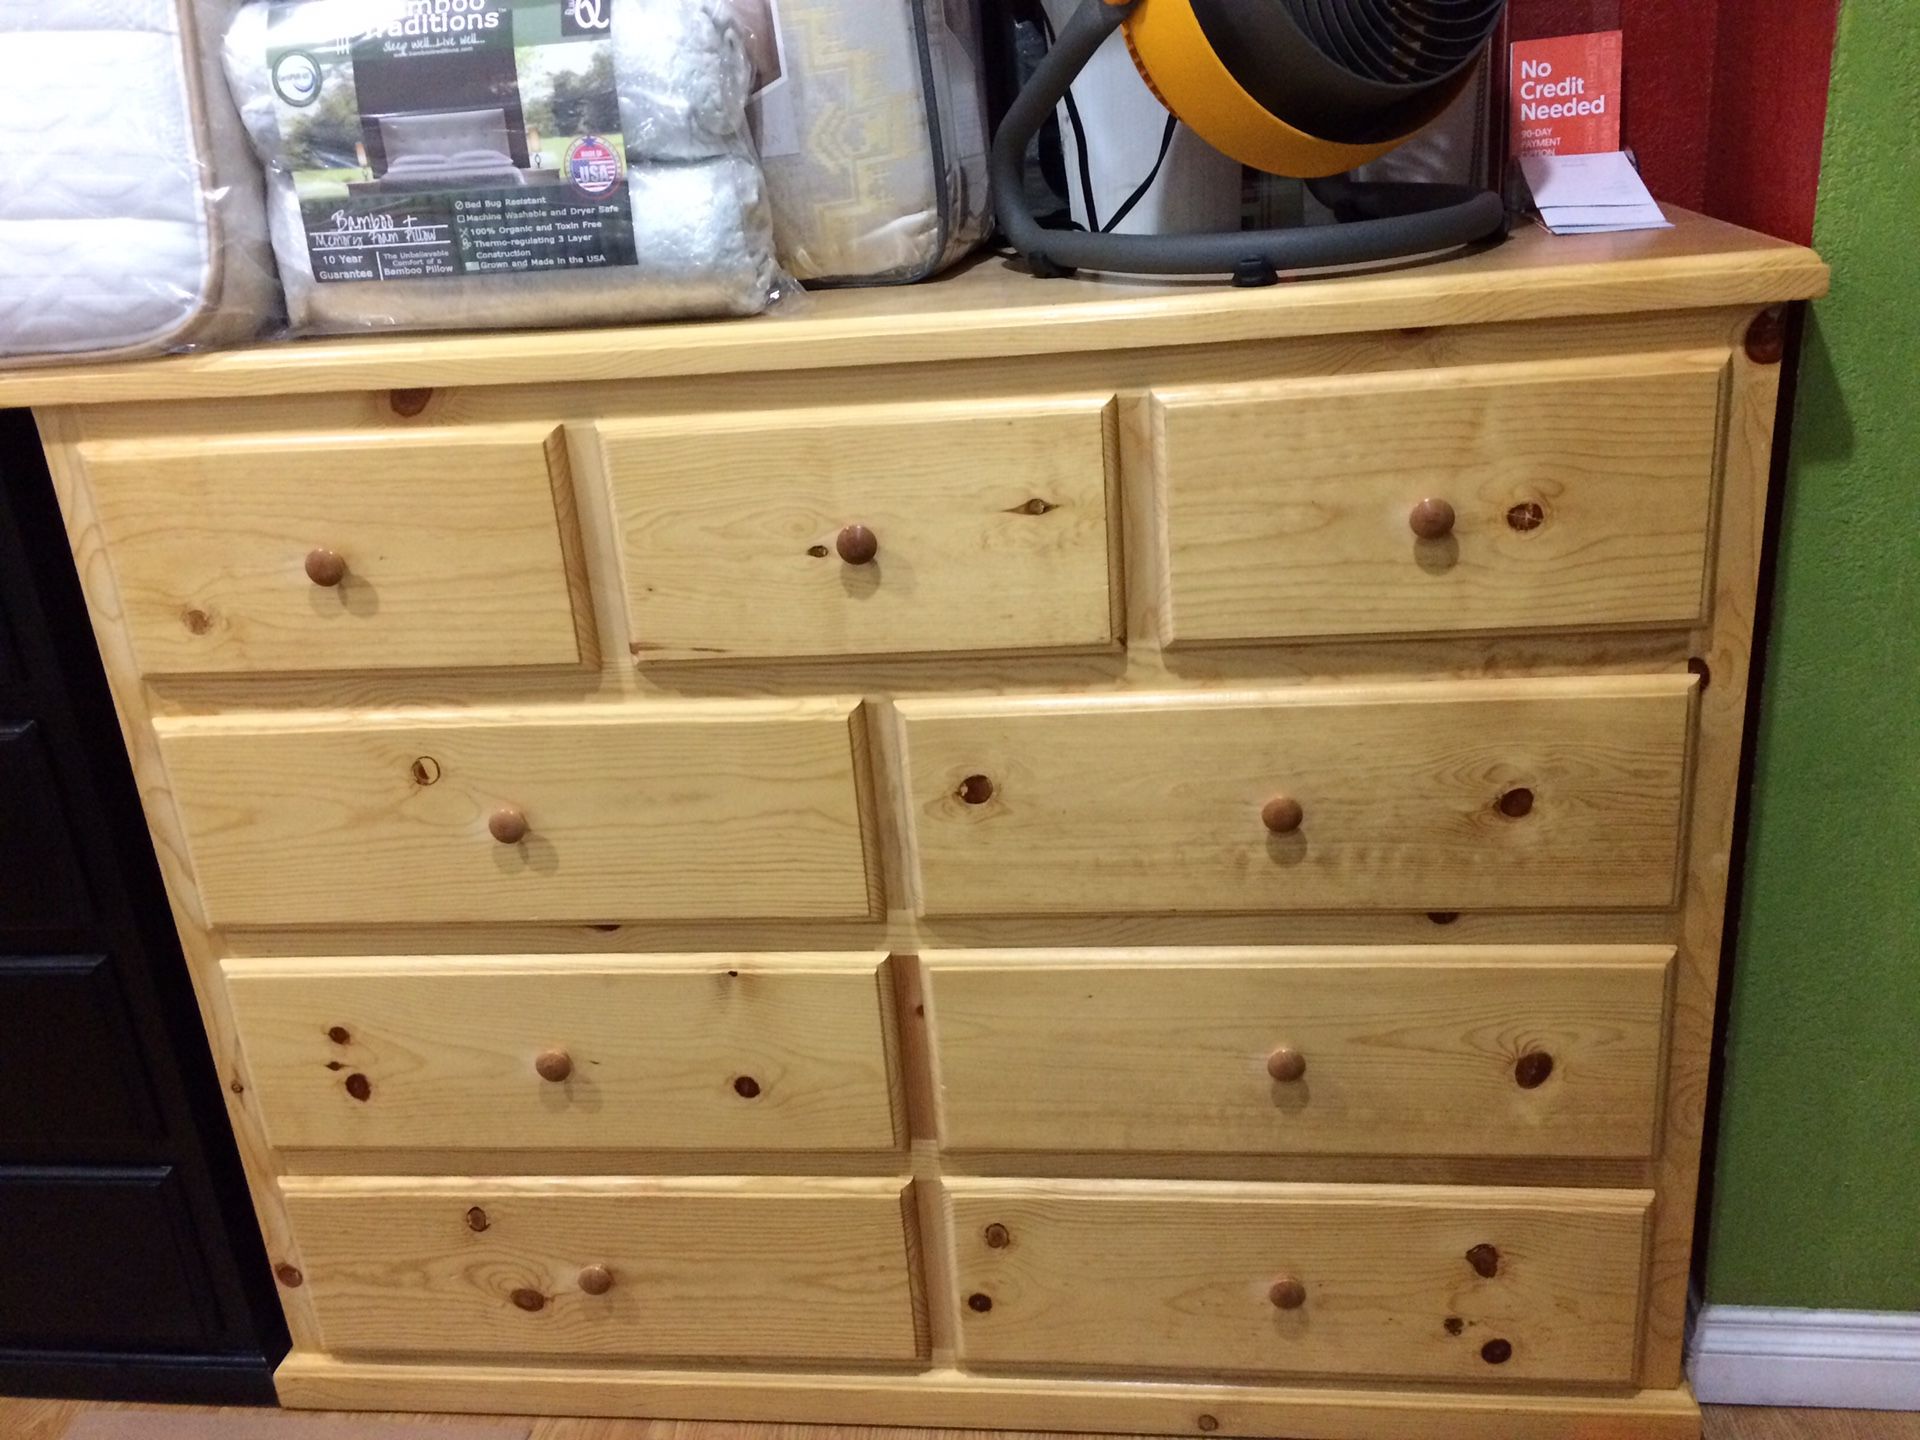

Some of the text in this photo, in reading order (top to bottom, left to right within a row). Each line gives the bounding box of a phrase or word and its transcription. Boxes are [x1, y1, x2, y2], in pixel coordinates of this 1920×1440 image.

[1521, 60, 1551, 79] No
[1520, 76, 1585, 100] Credit
[1521, 95, 1605, 120] Needed
[1521, 128, 1552, 138] 90-DAY
[1521, 137, 1561, 148] PAYMENT
[579, 164, 609, 183] USA
[464, 197, 547, 209] Bed Bug Resistant
[331, 209, 394, 233] Bamboo
[466, 204, 620, 223] Machine Washable and Dryer Safe
[470, 218, 603, 237] 100% Organic and Toxin Free
[315, 234, 363, 249] Memory
[404, 227, 438, 243] Pillow
[474, 232, 593, 249] Thermo-regulating 3 Layer
[322, 253, 364, 265] 10 Year
[383, 249, 450, 260] The Unbelievable
[392, 258, 424, 267] Comfort
[426, 256, 435, 264] of
[476, 249, 532, 260] Construction
[480, 260, 508, 270] Grown
[511, 259, 528, 268] and
[531, 257, 555, 266] Made
[568, 255, 584, 264] the
[586, 253, 607, 263] USA
[319, 270, 374, 281] Guarantee
[383, 263, 454, 277] Bamboo Pillow
